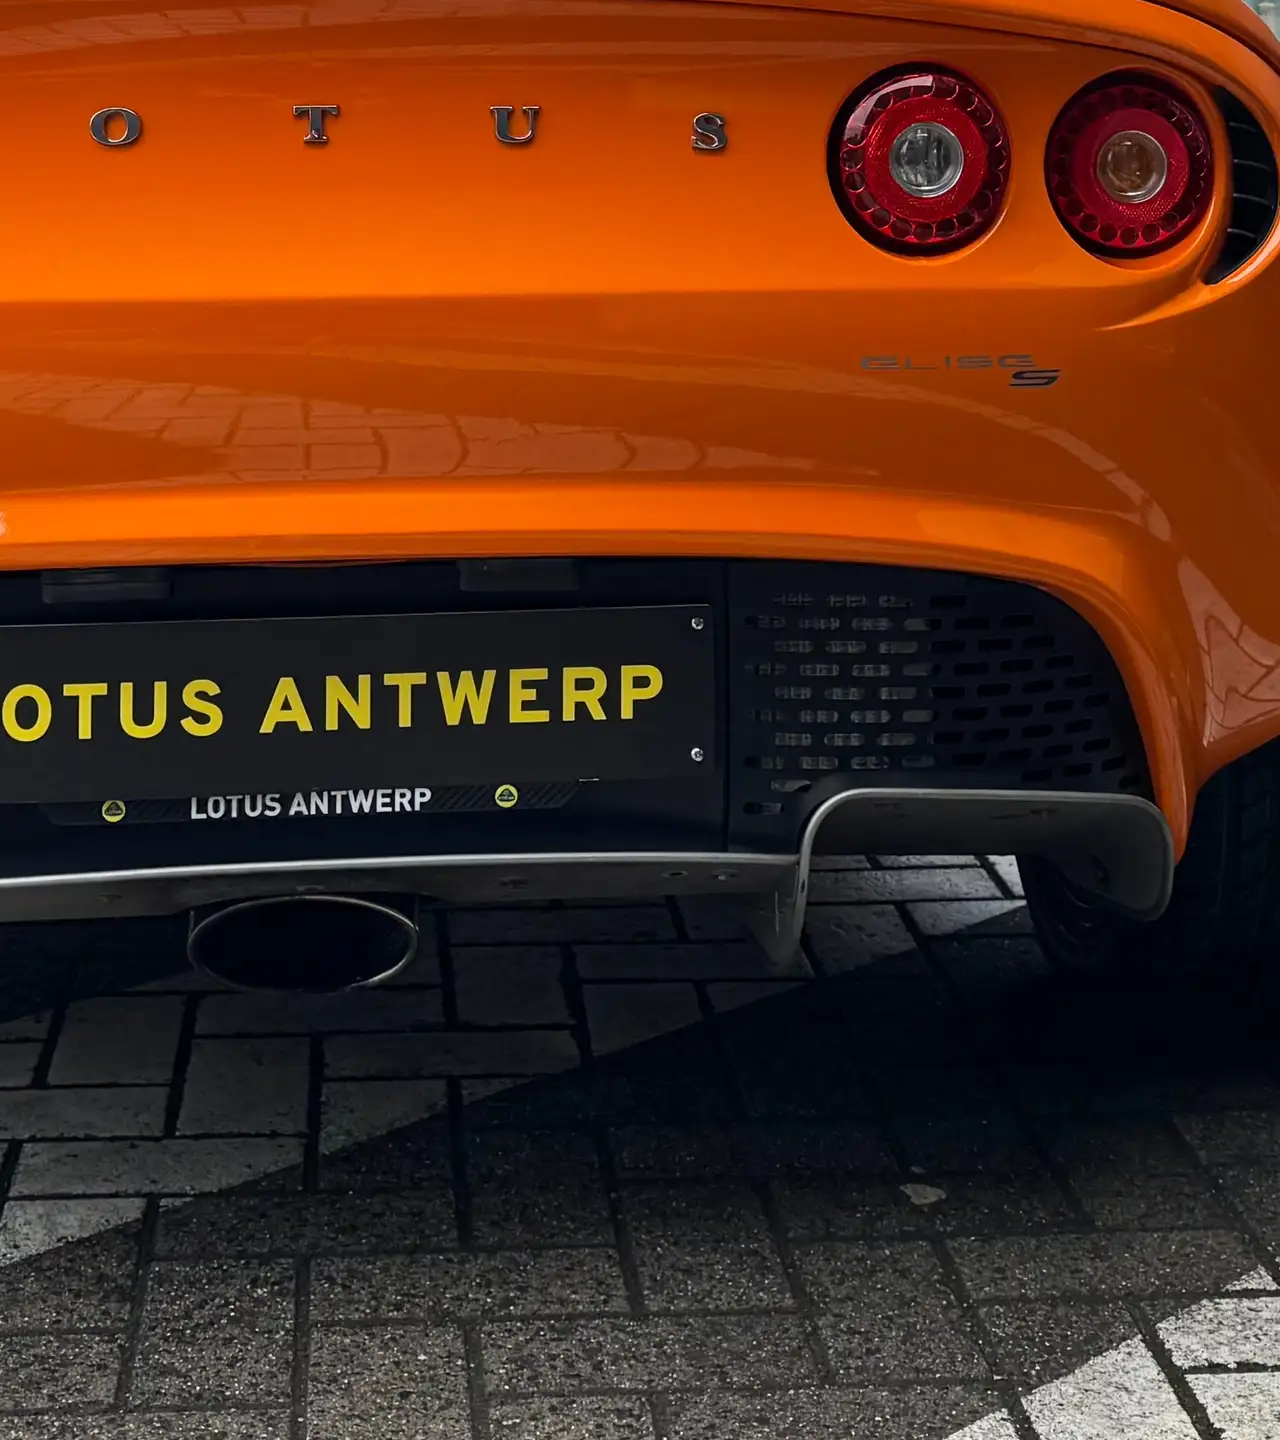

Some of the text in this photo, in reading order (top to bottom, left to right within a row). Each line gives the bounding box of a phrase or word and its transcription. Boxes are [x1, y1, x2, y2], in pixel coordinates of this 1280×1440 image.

[860, 353, 1062, 388] ELISE S
[258, 664, 664, 734] ANTWERP
[190, 787, 432, 820] LOTUS ANTWERP
